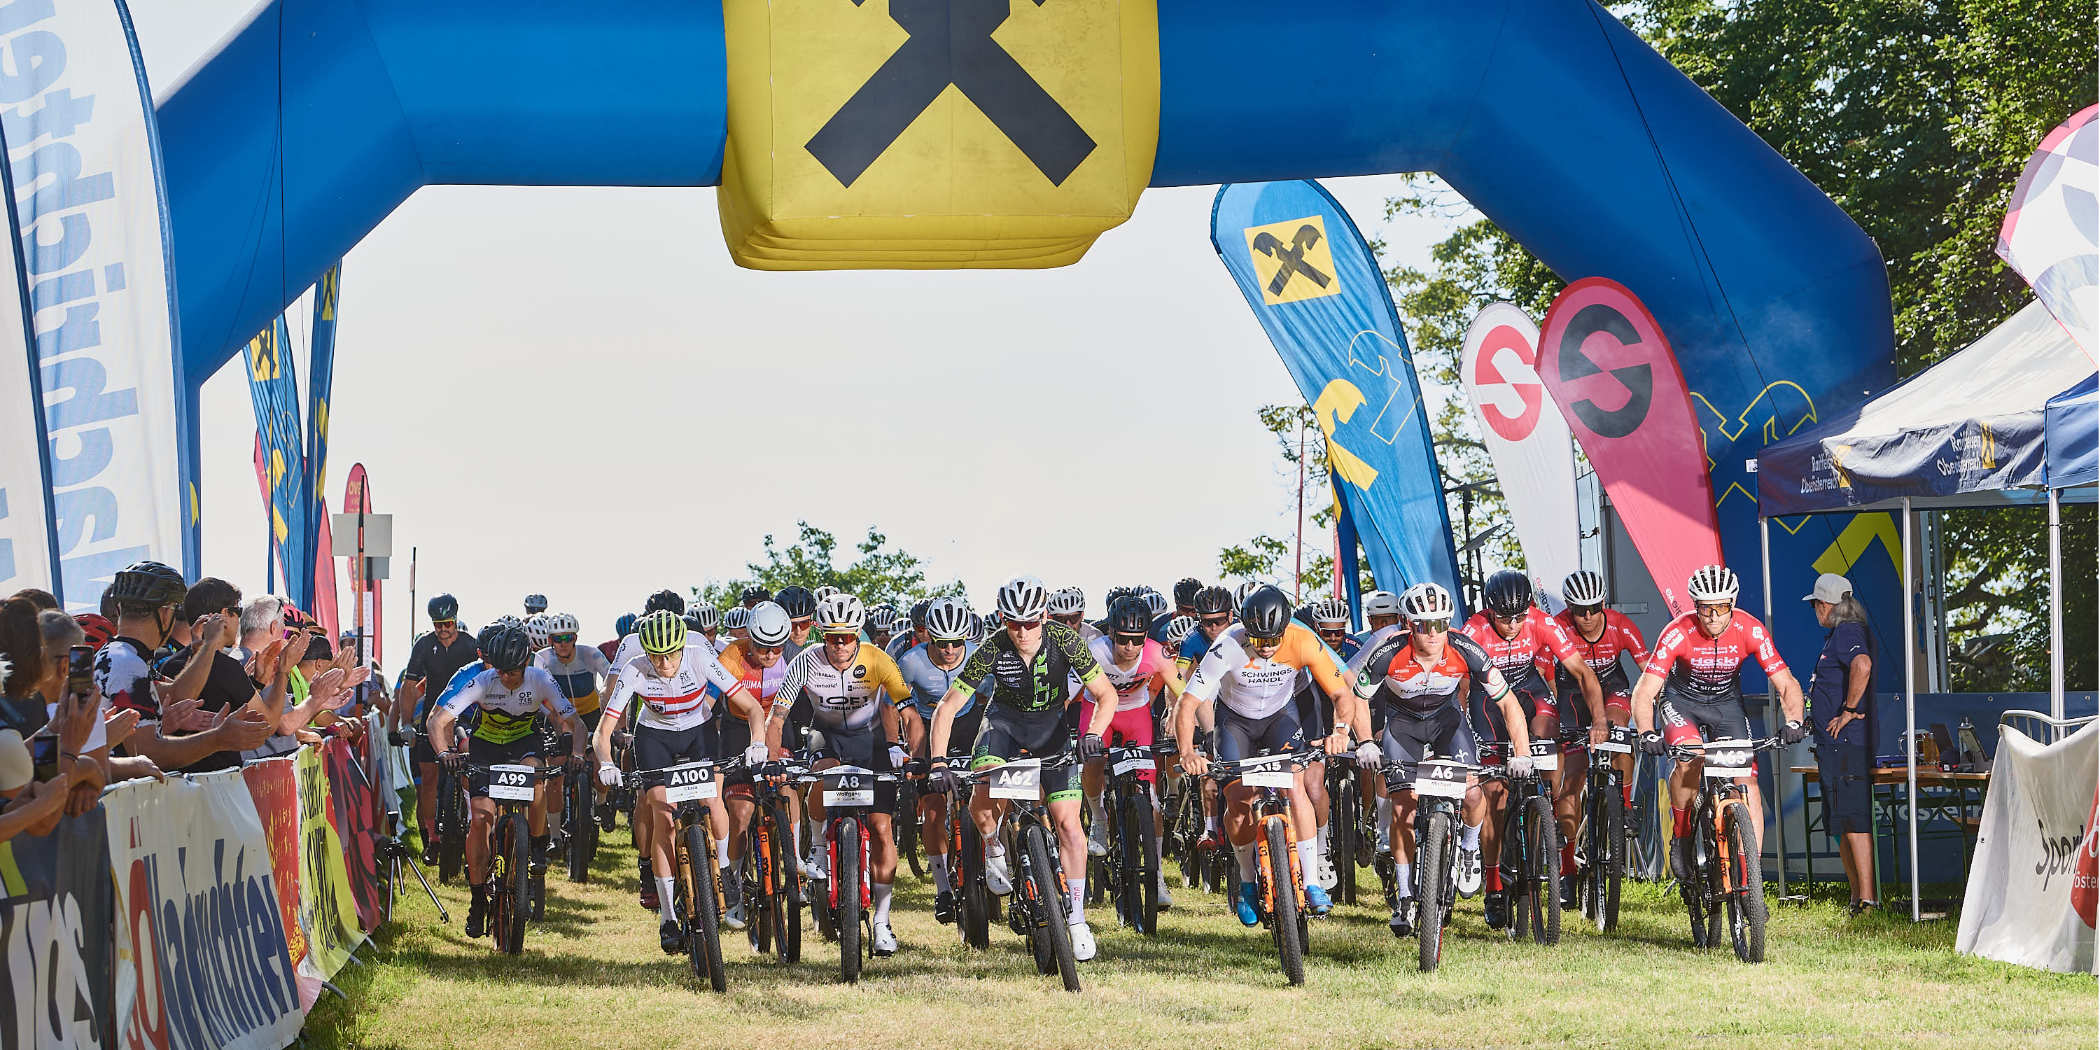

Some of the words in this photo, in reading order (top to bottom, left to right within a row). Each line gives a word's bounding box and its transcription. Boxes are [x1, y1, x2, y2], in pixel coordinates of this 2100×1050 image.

[1241, 667, 1293, 678] SCHWINGS
[1247, 677, 1283, 685] HANDL
[1122, 749, 1143, 760] A11
[1530, 745, 1548, 756] 12
[497, 772, 527, 786] A99
[670, 768, 709, 786] A100
[998, 769, 1033, 786] A62
[1431, 765, 1453, 779] A6
[837, 775, 860, 789] A8
